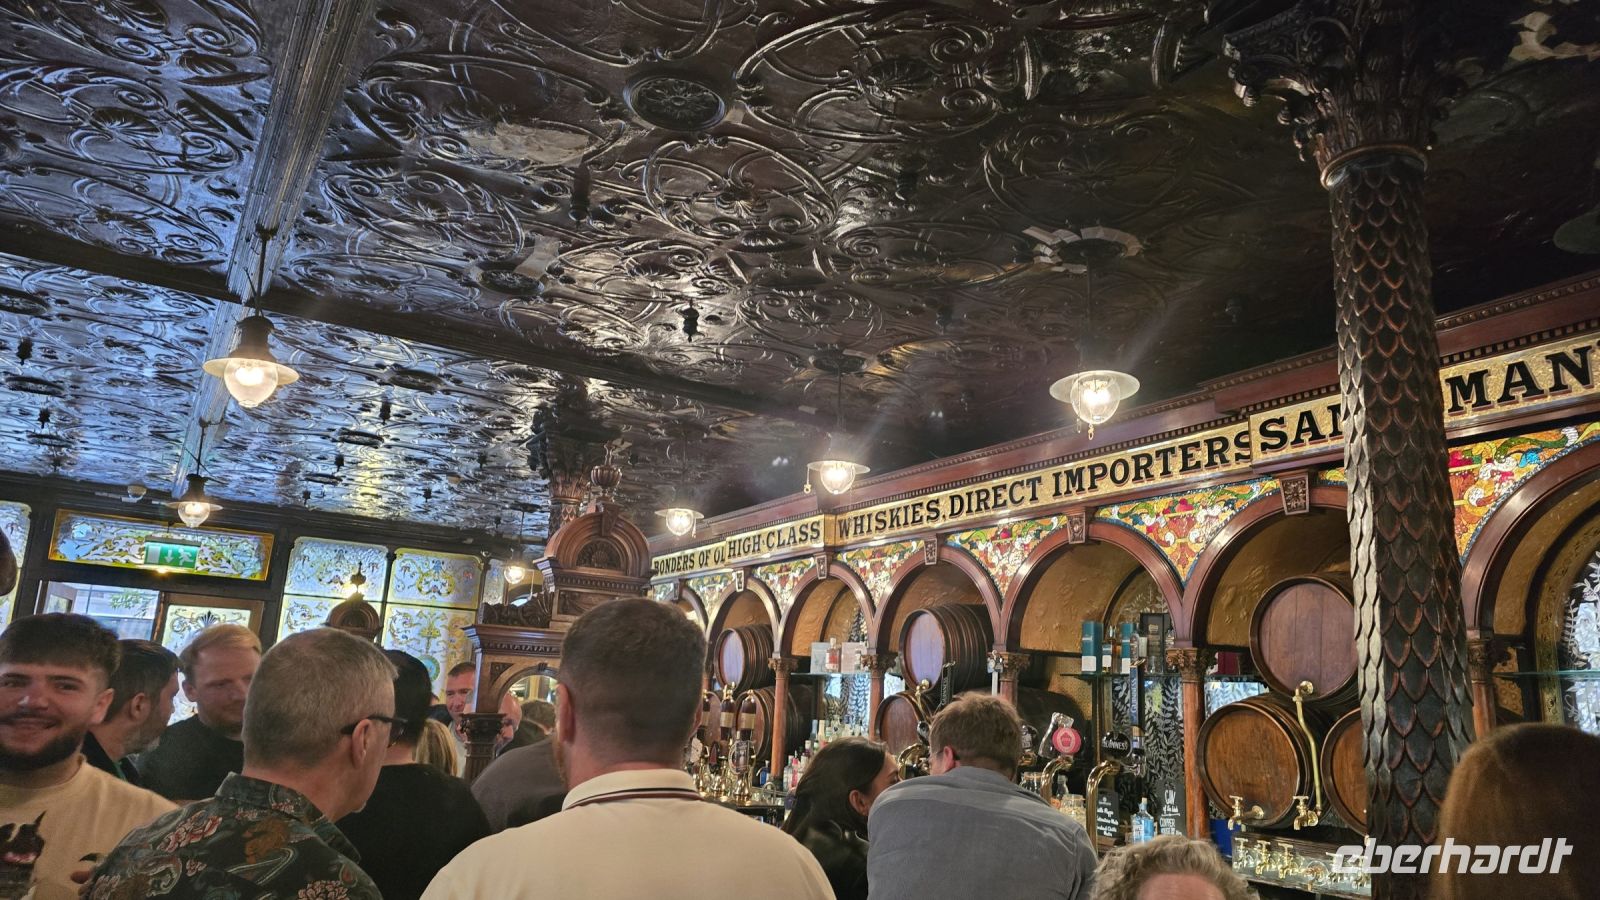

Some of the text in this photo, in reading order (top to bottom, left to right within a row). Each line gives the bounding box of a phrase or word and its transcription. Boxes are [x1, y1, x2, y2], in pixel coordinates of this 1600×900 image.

[949, 476, 1042, 517] DIRECT
[1052, 430, 1250, 497] IMPORTERS
[654, 546, 726, 575] BONDERS OF OL
